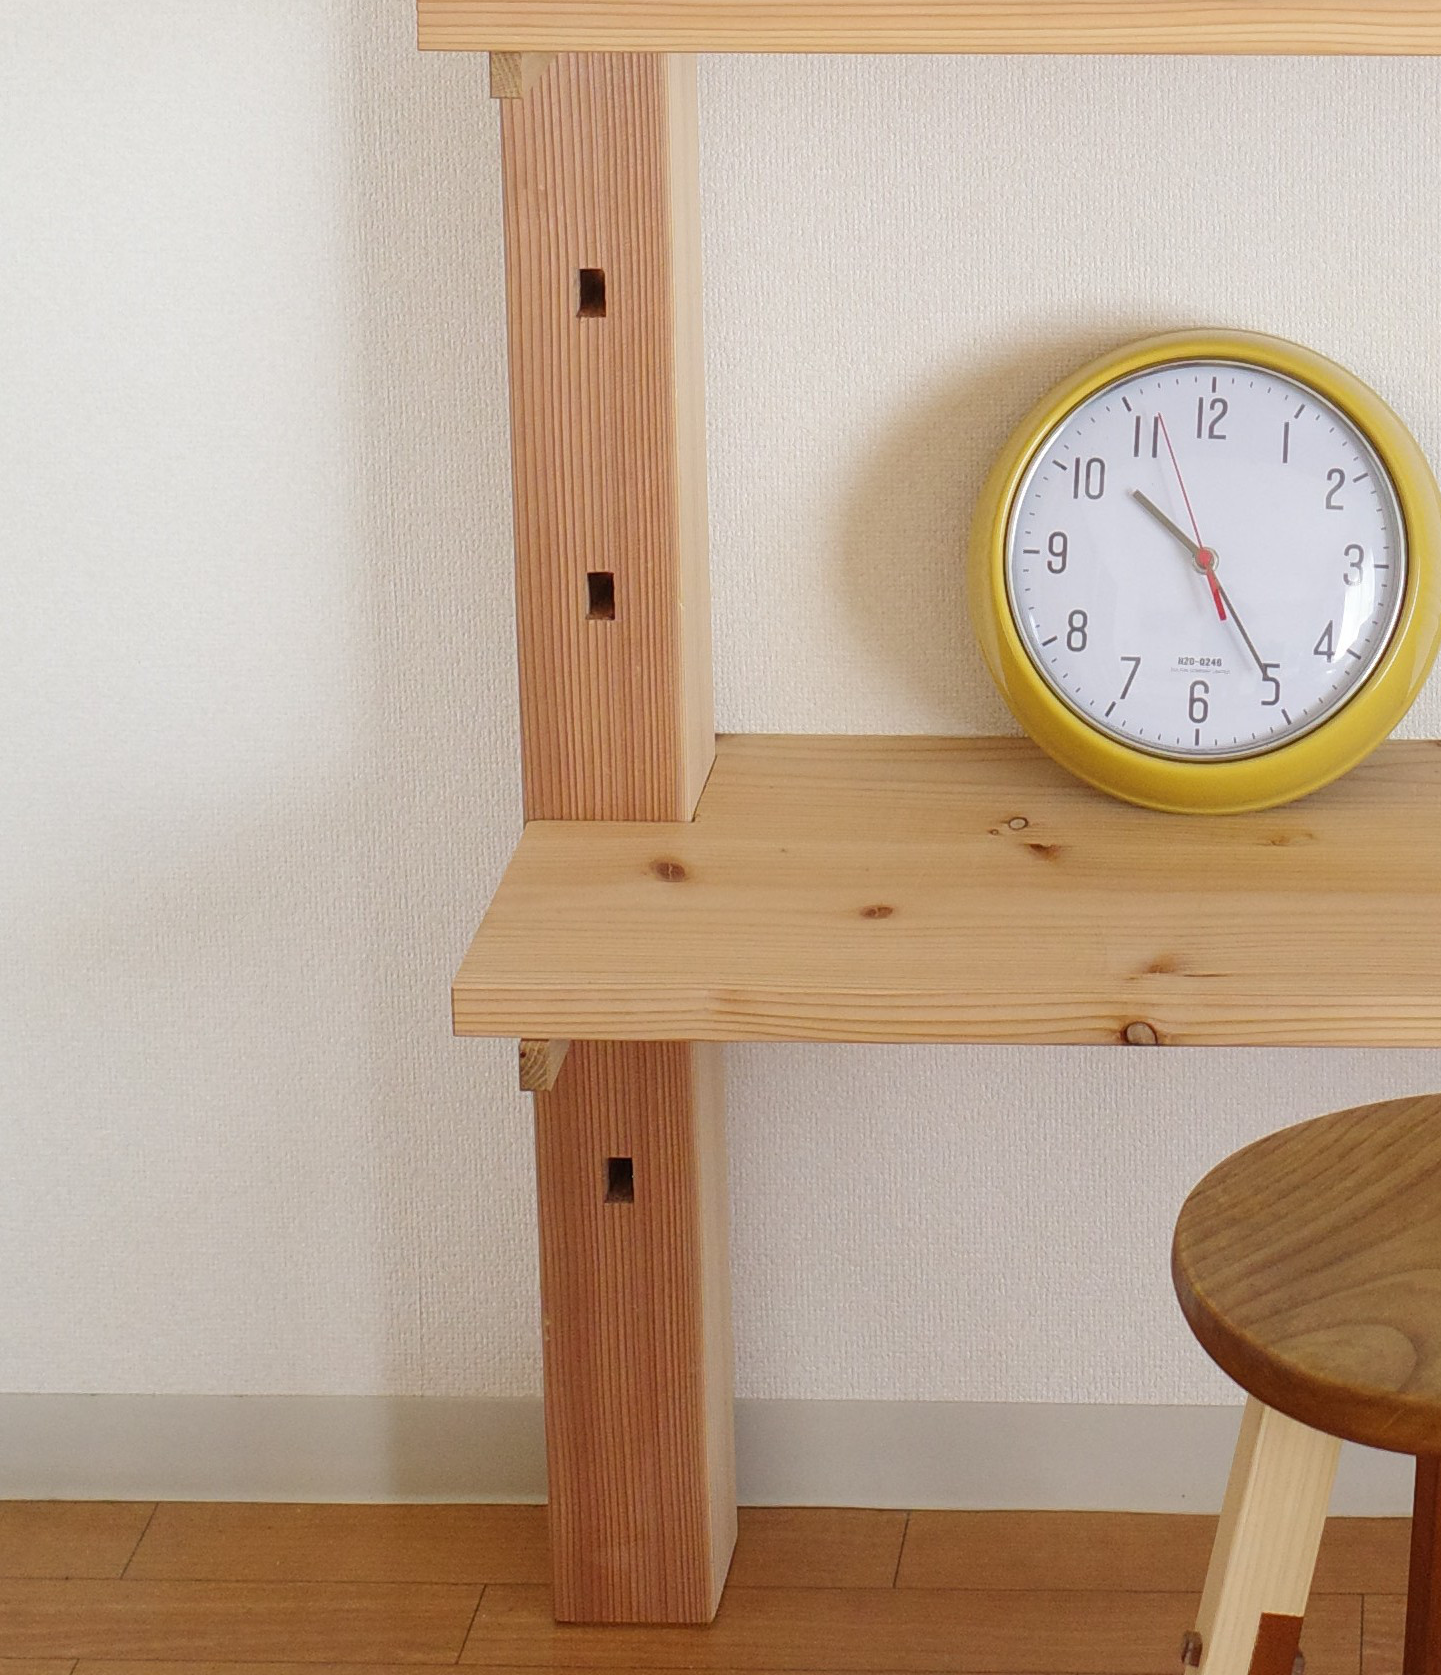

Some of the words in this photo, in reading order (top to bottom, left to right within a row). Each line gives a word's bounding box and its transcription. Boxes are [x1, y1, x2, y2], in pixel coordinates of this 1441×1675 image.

[1134, 415, 1158, 458] 11
[1196, 396, 1228, 440] 12
[1282, 421, 1290, 464] 1
[1073, 457, 1106, 500] 10
[1325, 468, 1346, 510] 2
[1047, 531, 1068, 574] 9
[1343, 544, 1364, 586] 3
[1066, 609, 1089, 652] 8
[1313, 620, 1335, 663] 4
[1120, 656, 1141, 700] 7
[1261, 663, 1281, 706] 5
[1188, 680, 1209, 724] 6
